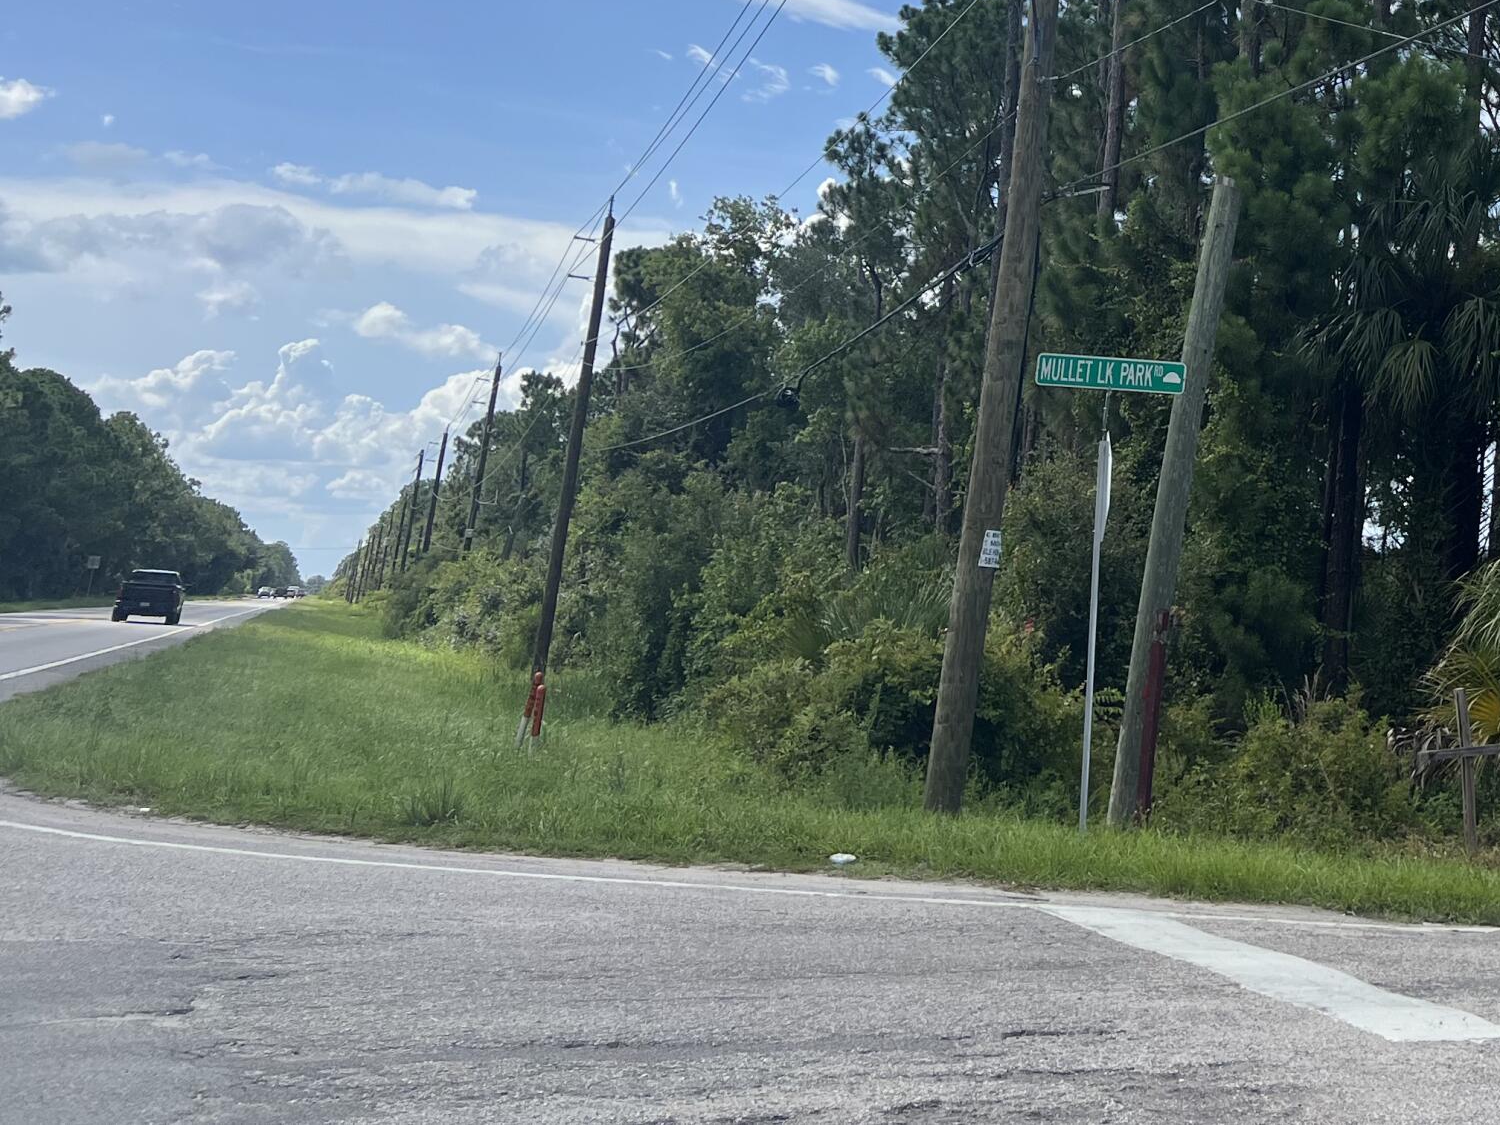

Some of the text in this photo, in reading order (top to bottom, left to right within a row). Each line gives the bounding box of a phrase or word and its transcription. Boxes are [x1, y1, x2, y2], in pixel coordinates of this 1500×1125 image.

[1040, 358, 1163, 386] MULLET LK PARK RD
